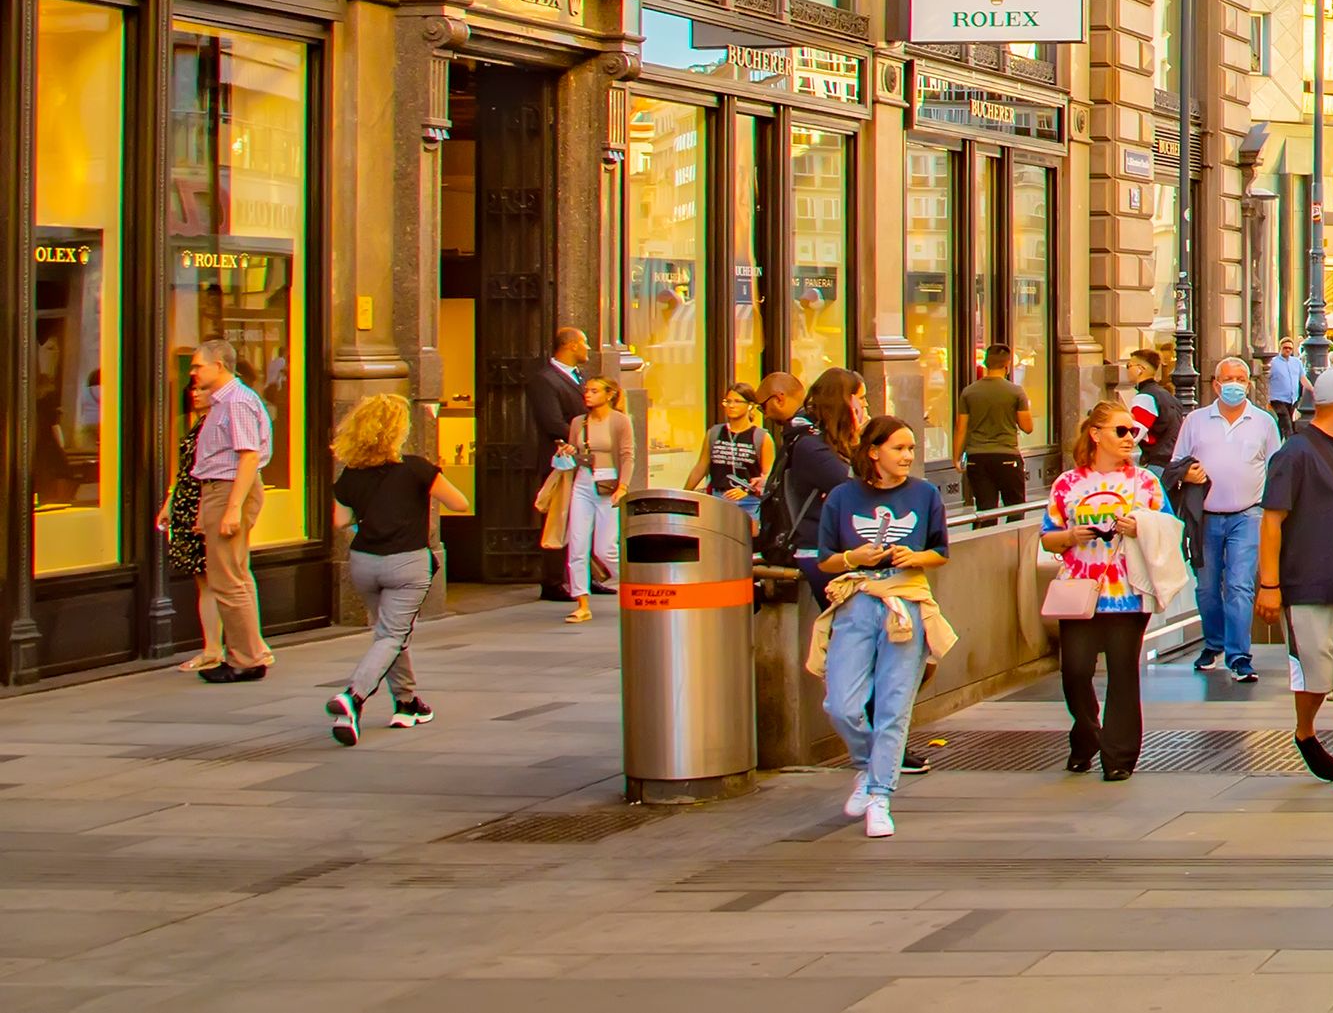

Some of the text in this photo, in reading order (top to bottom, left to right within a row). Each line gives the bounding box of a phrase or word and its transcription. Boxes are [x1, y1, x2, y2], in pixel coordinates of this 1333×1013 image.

[952, 10, 1040, 28] ROLEX
[726, 43, 795, 78] BUCHERER
[969, 98, 1016, 125] BUCHERER
[194, 252, 239, 269] ROLEX
